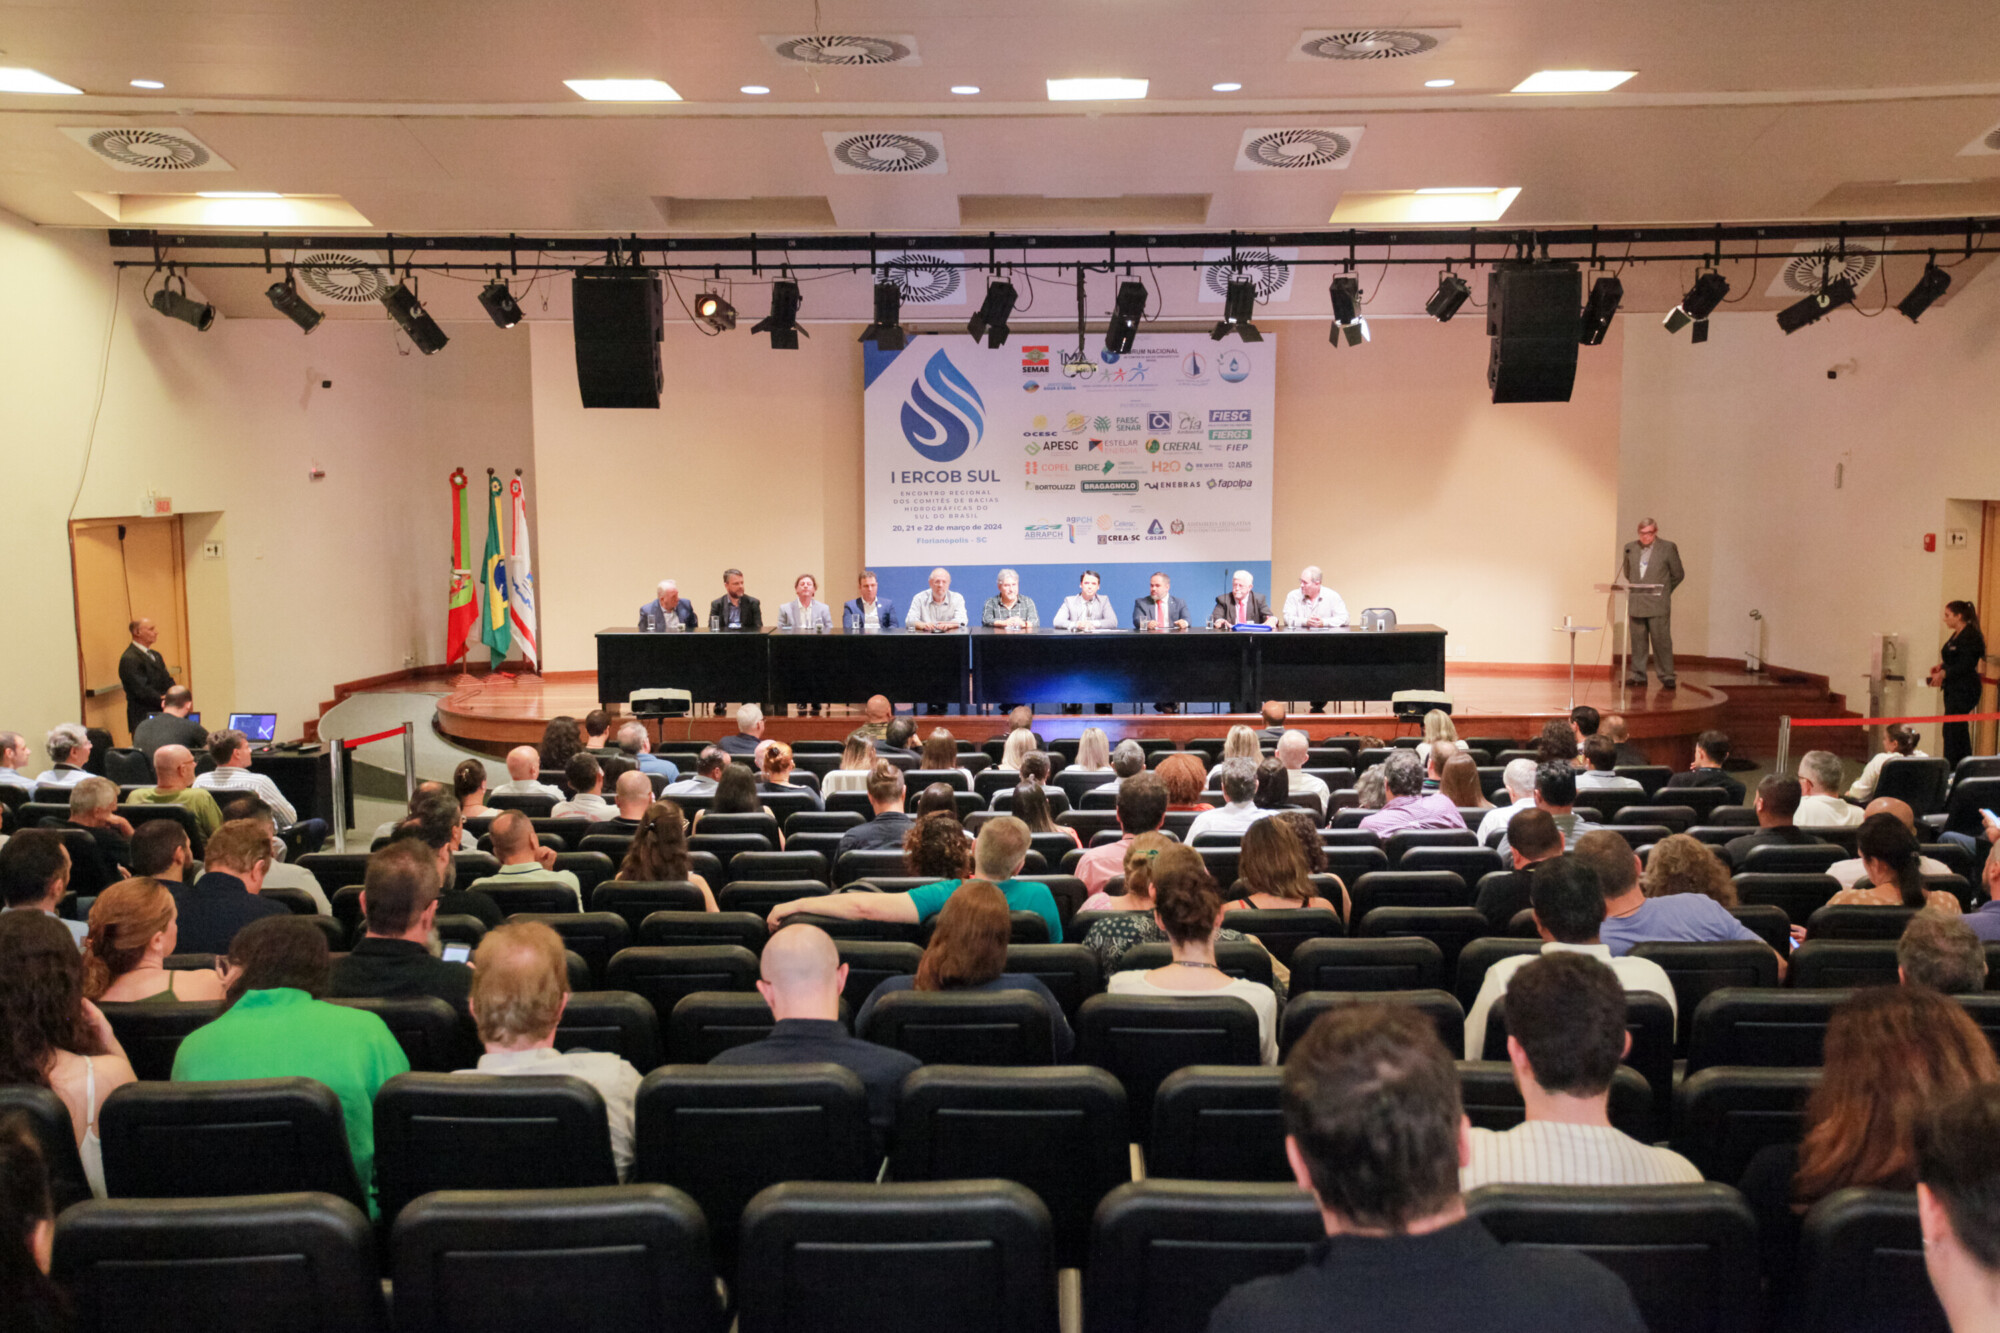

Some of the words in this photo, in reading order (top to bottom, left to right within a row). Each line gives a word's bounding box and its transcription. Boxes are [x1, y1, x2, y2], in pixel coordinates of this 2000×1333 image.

[1116, 416, 1140, 424] FAESC
[1212, 411, 1249, 421] FIESC
[1212, 430, 1249, 439] FIERGS
[1043, 441, 1079, 451] APESC
[1163, 441, 1203, 451] CRERAL
[1226, 443, 1249, 451] FIEP
[1041, 463, 1070, 472] COPEL
[1074, 463, 1100, 471] BRDE
[1151, 460, 1181, 473] H2O
[1235, 461, 1252, 469] ARIS
[891, 471, 895, 484] I
[901, 470, 962, 484] ERCOB
[967, 469, 1000, 483] SUL
[1083, 482, 1136, 490] BRAGAGNOLO
[1160, 481, 1201, 489] ENEBRAS
[1217, 478, 1253, 489] fapolpa
